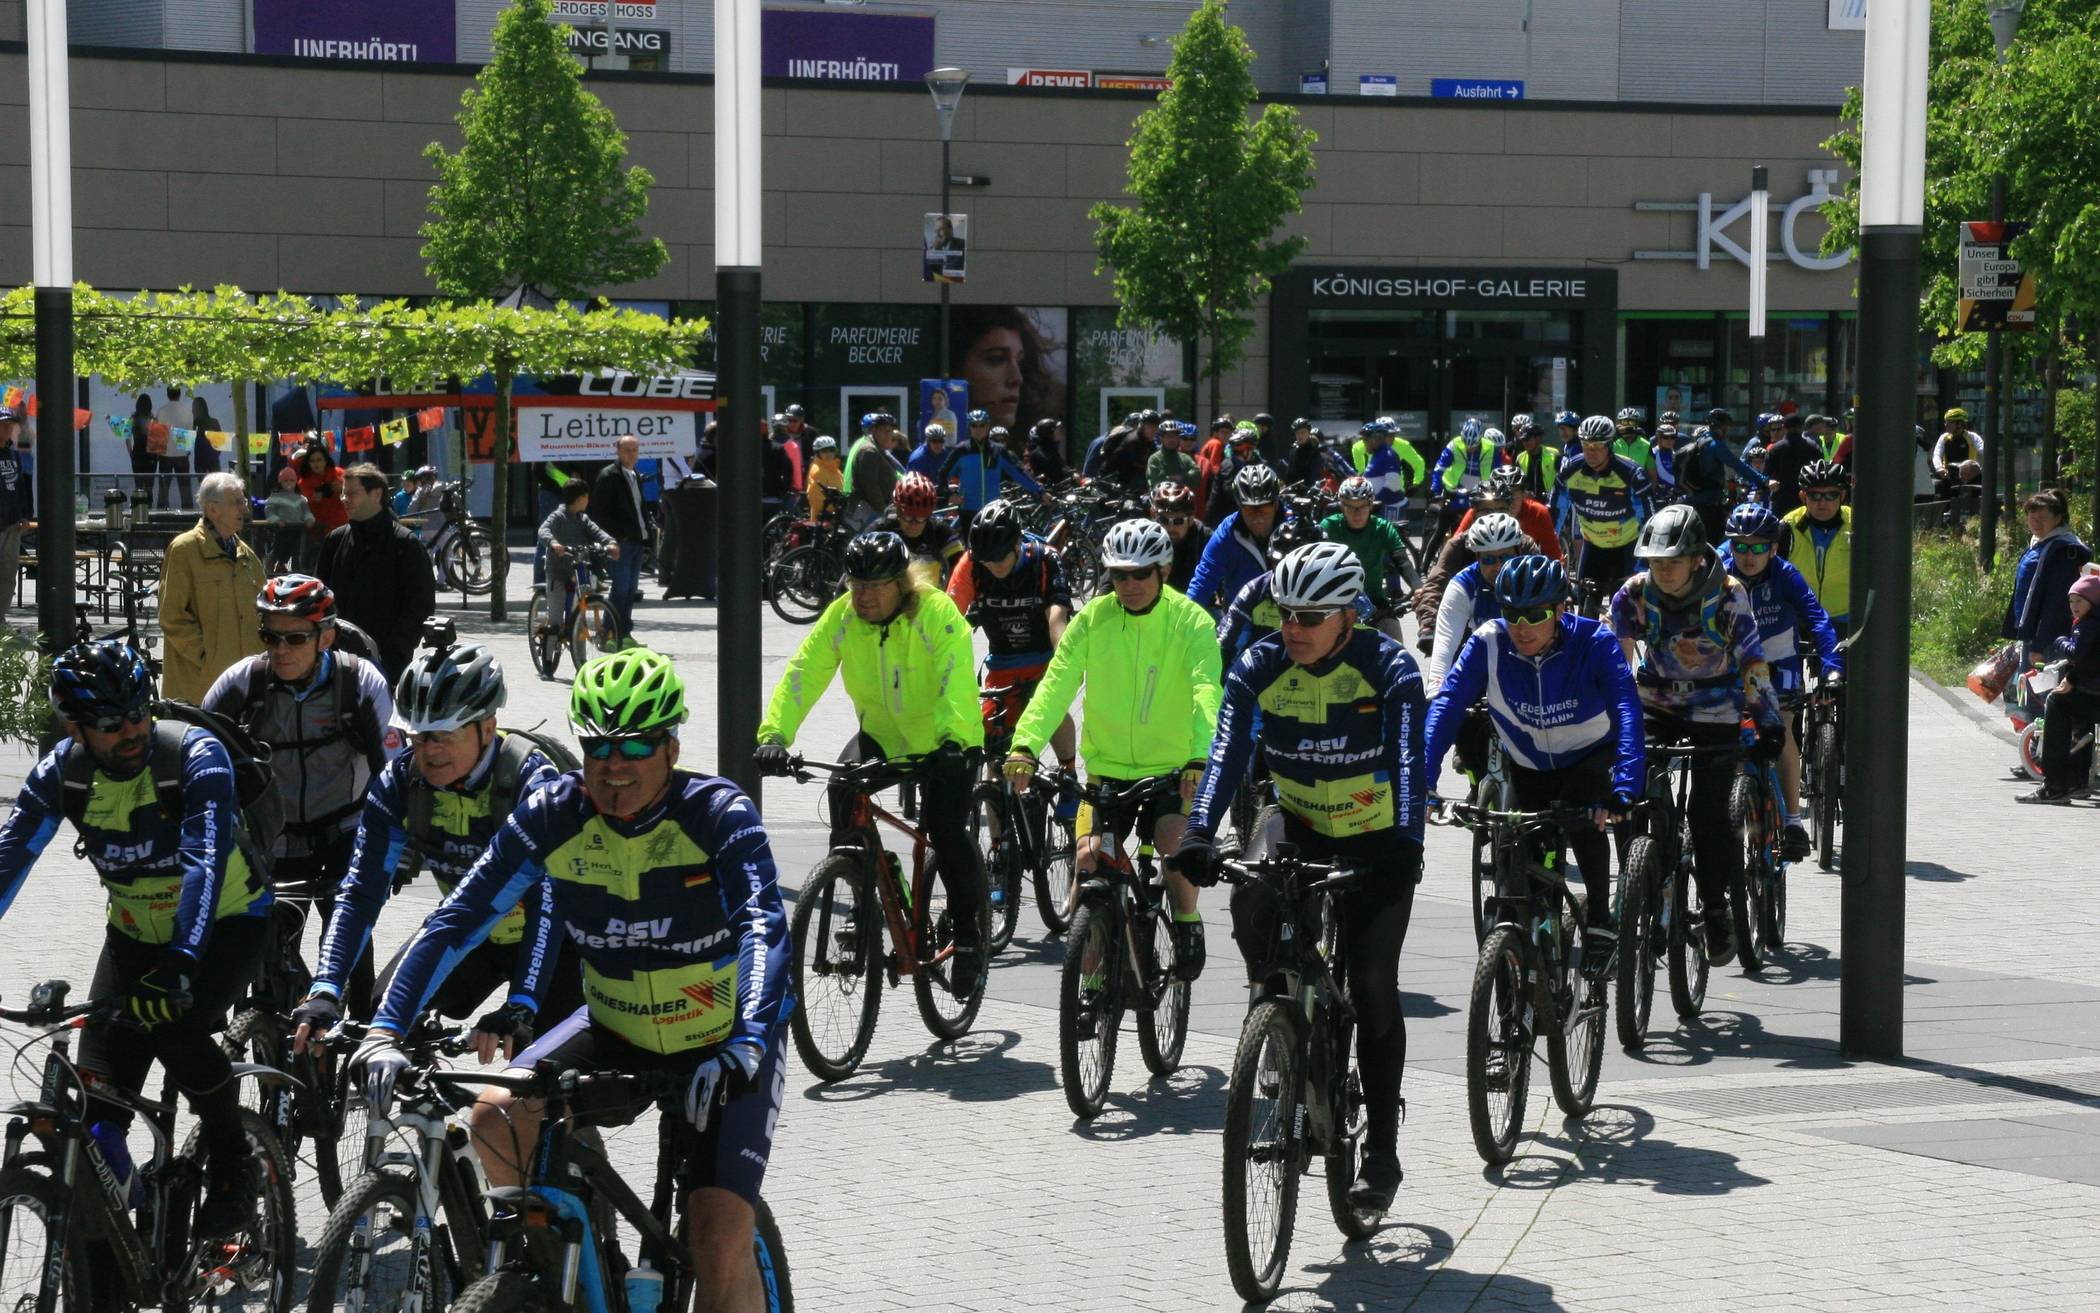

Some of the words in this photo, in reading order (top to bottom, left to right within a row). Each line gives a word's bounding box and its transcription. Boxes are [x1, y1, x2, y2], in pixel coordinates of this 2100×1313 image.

[553, 3, 653, 18] ERDGESHOSS
[568, 31, 661, 50] INGANG
[1455, 85, 1502, 99] Ausfahrt
[1967, 249, 1996, 259] Unser
[1984, 263, 2016, 272] Europa
[1312, 273, 1586, 297] KÖNIGSHOF-GALERIE
[1977, 276, 1996, 287] gibt
[1966, 288, 2013, 298] Sicherheit
[830, 328, 920, 345] PARFÜMERIE
[848, 346, 902, 363] BECKER
[540, 413, 674, 439] Leitner
[605, 917, 673, 941] PSV
[590, 985, 688, 1016] GRIESHABER
[652, 1008, 704, 1026] Logistik
